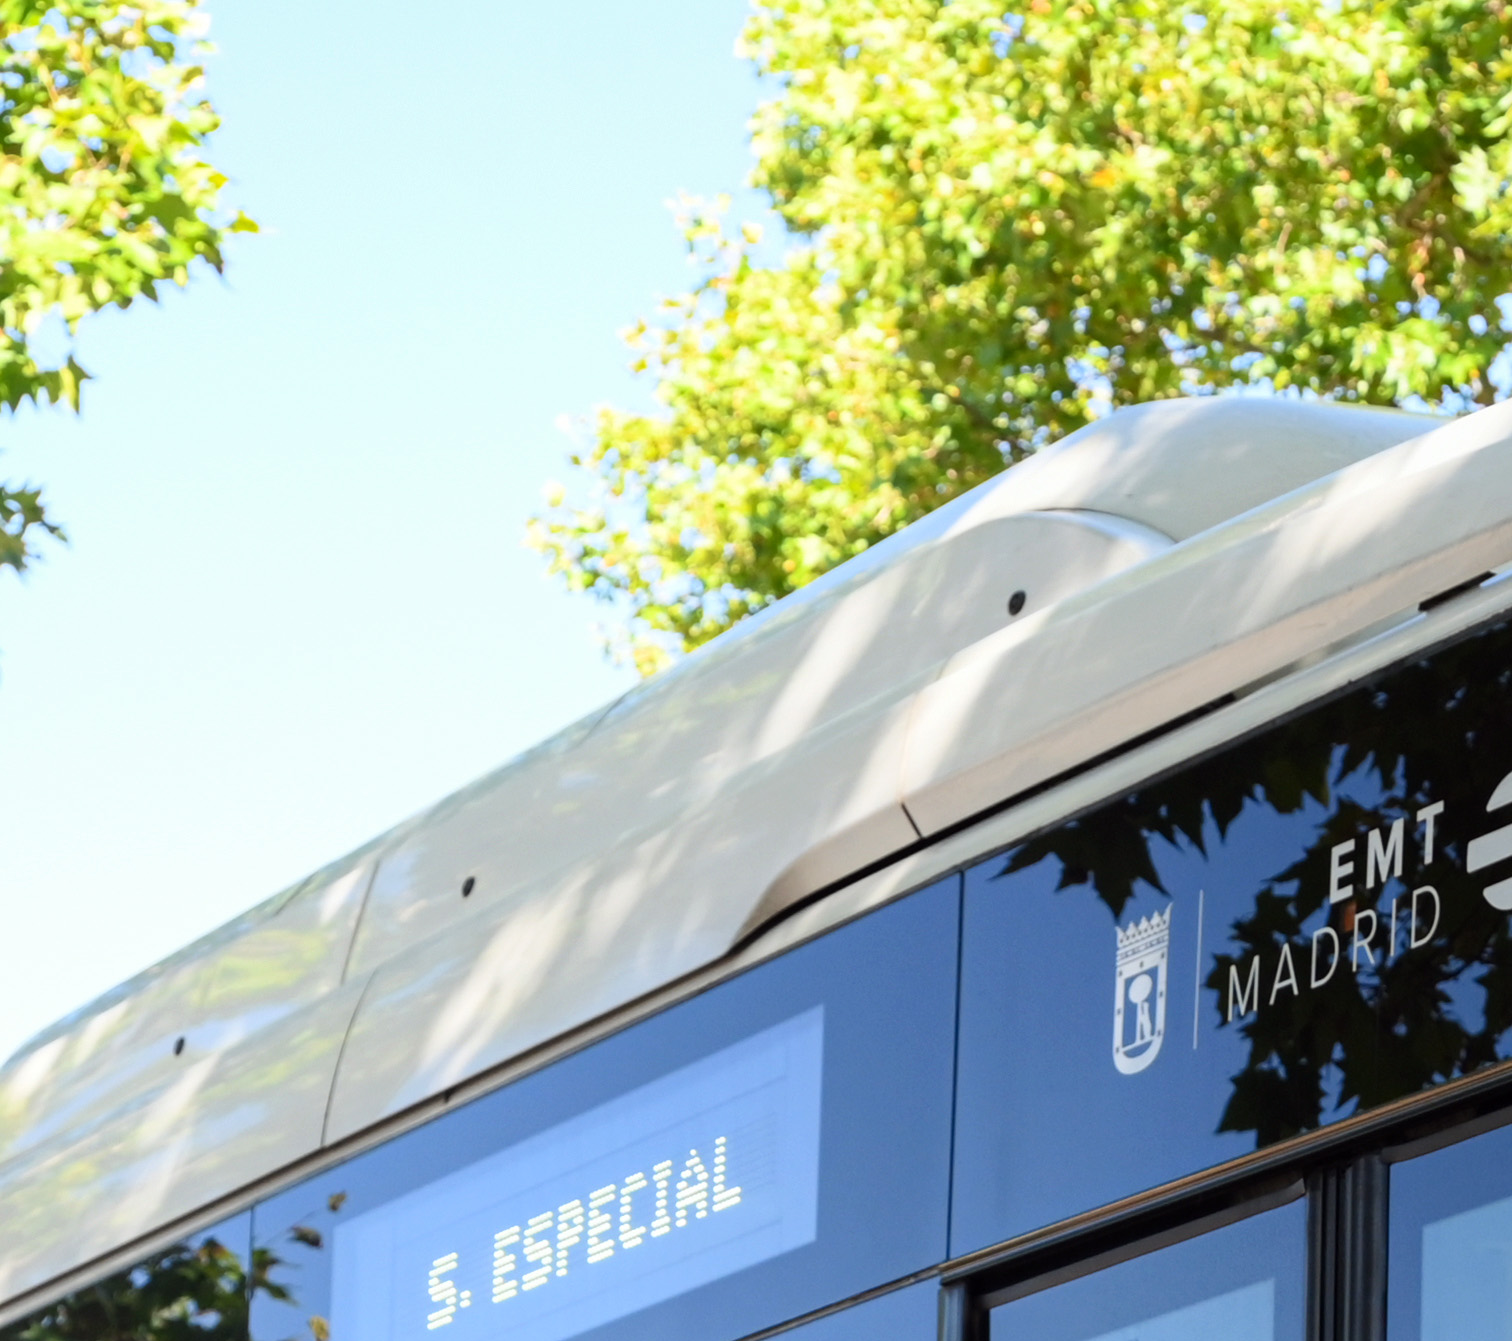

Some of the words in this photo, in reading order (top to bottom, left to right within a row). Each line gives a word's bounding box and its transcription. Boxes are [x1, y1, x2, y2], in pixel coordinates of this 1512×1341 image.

[1328, 800, 1445, 904] EMT
[1226, 884, 1442, 1023] MADRID
[427, 1251, 471, 1330] S.
[491, 1136, 742, 1304] ESPECIAL
